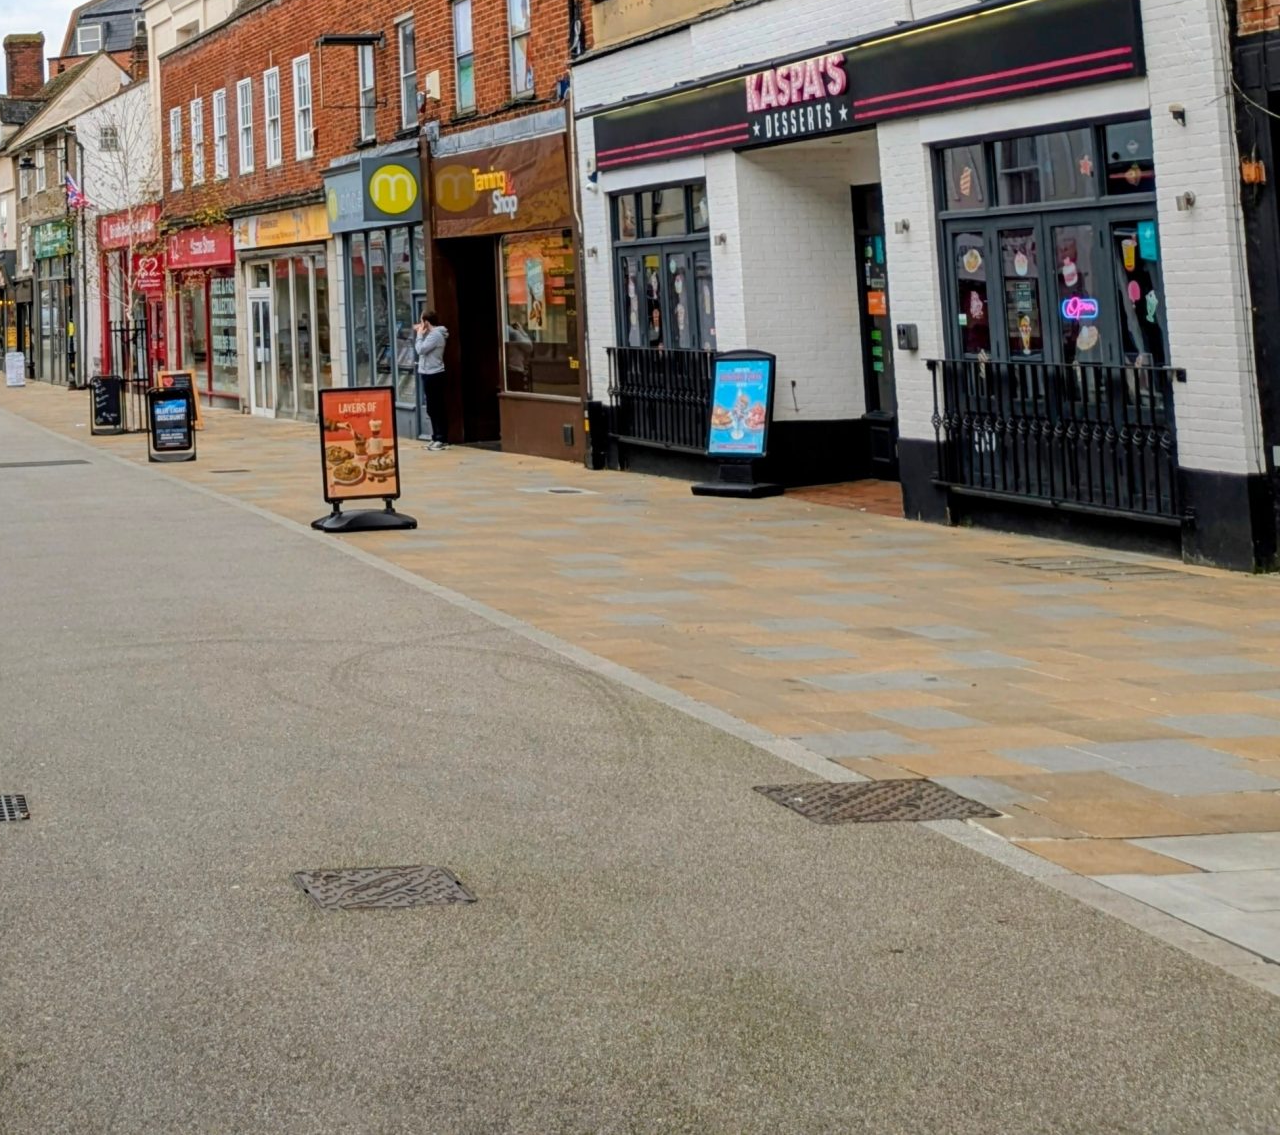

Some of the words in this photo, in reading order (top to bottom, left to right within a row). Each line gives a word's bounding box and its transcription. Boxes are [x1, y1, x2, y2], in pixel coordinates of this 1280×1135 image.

[745, 52, 848, 113] KASPA'S
[765, 102, 832, 138] DESSERTS
[471, 166, 506, 194] Tanning
[492, 190, 518, 219] Shop
[1067, 297, 1096, 320] Open
[338, 402, 366, 414] LAYERS
[367, 402, 377, 412] OF
